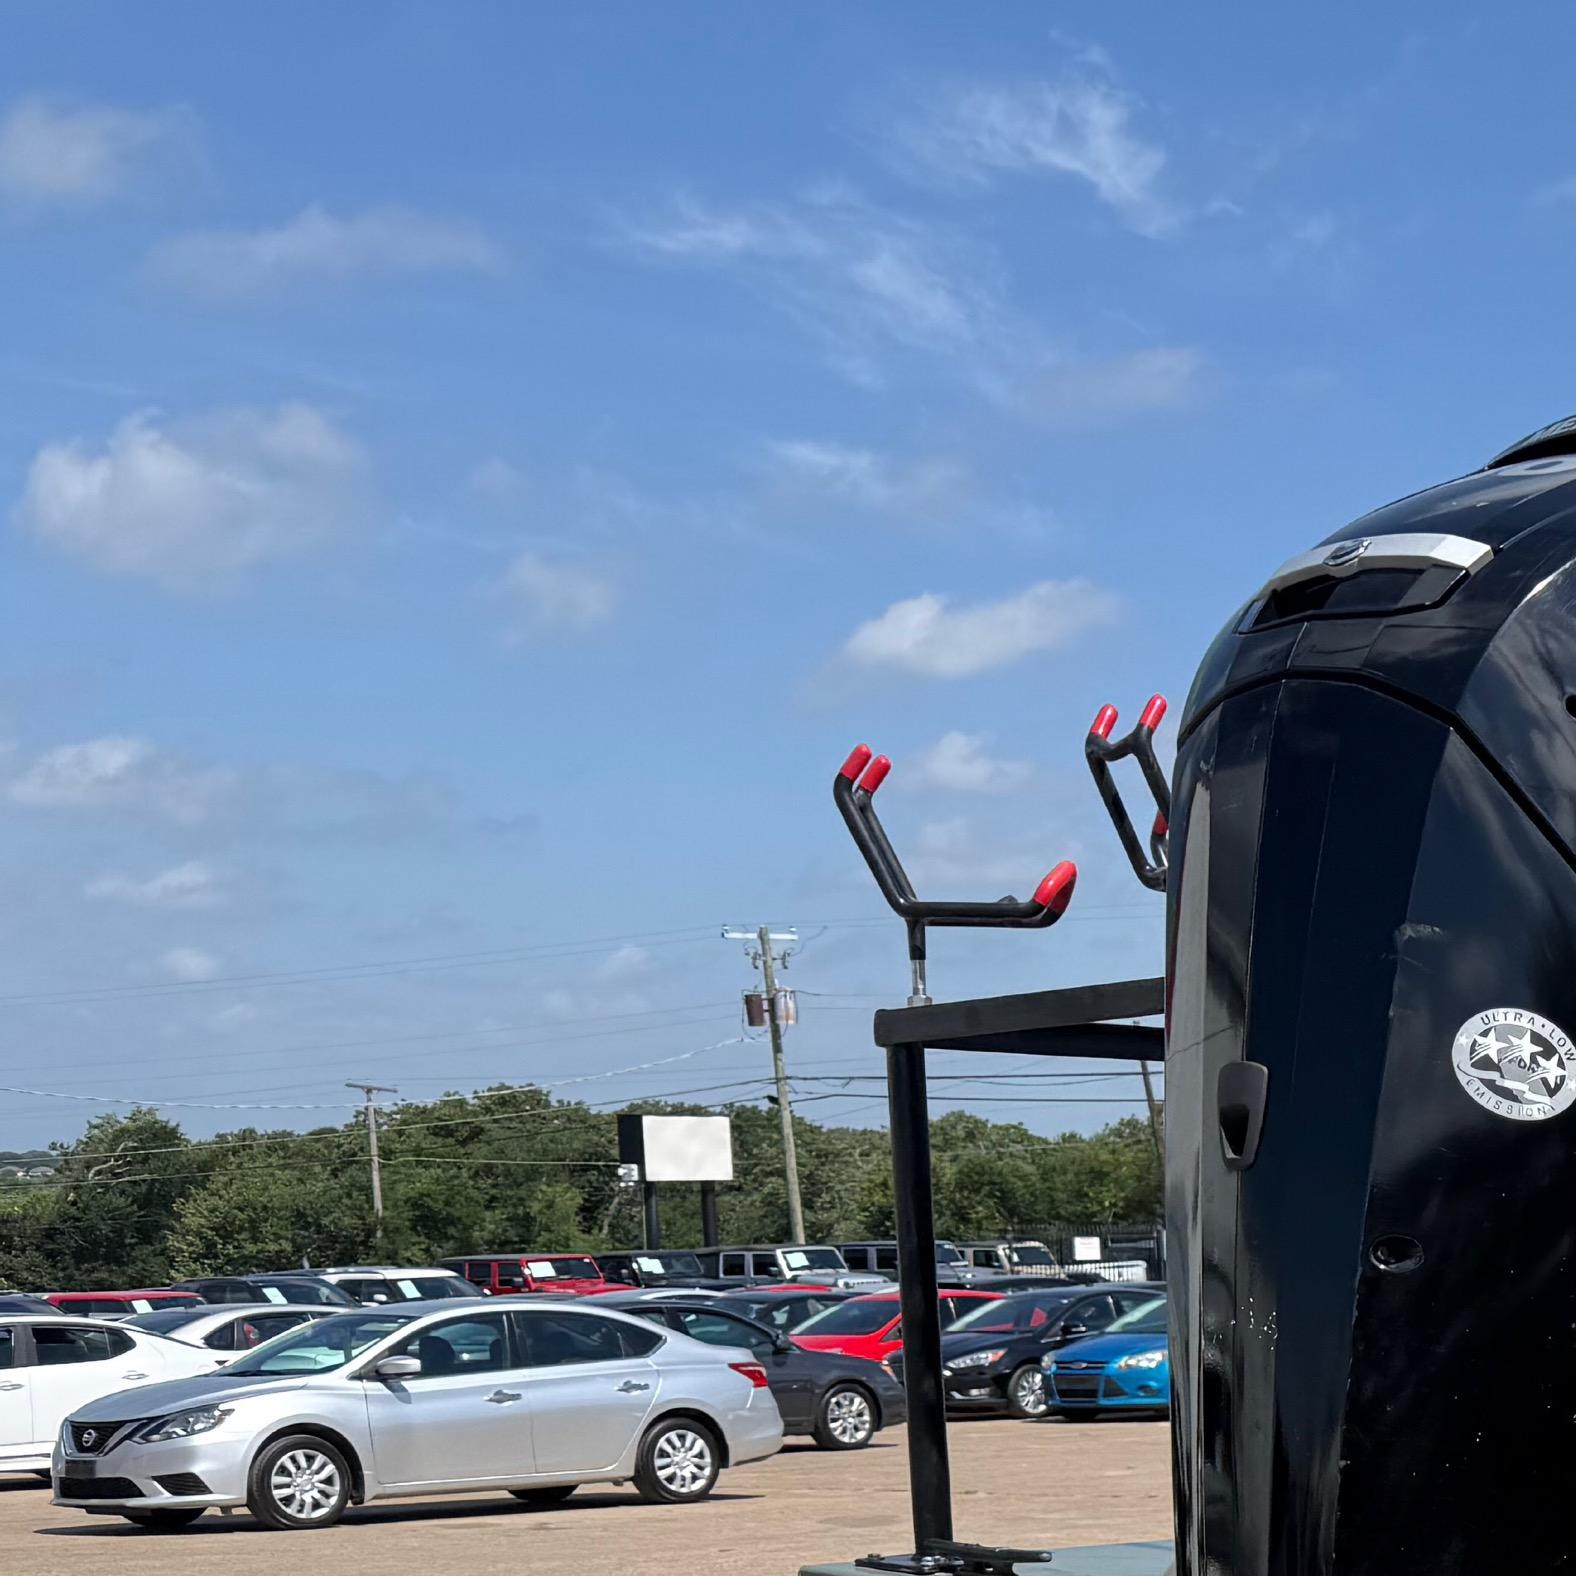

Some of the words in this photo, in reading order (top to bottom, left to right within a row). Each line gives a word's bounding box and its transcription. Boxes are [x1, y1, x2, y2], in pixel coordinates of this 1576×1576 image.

[1480, 1011, 1536, 1028] ULTRA
[1549, 1027, 1576, 1062] LOW
[1466, 1078, 1548, 1117] EMISSION
